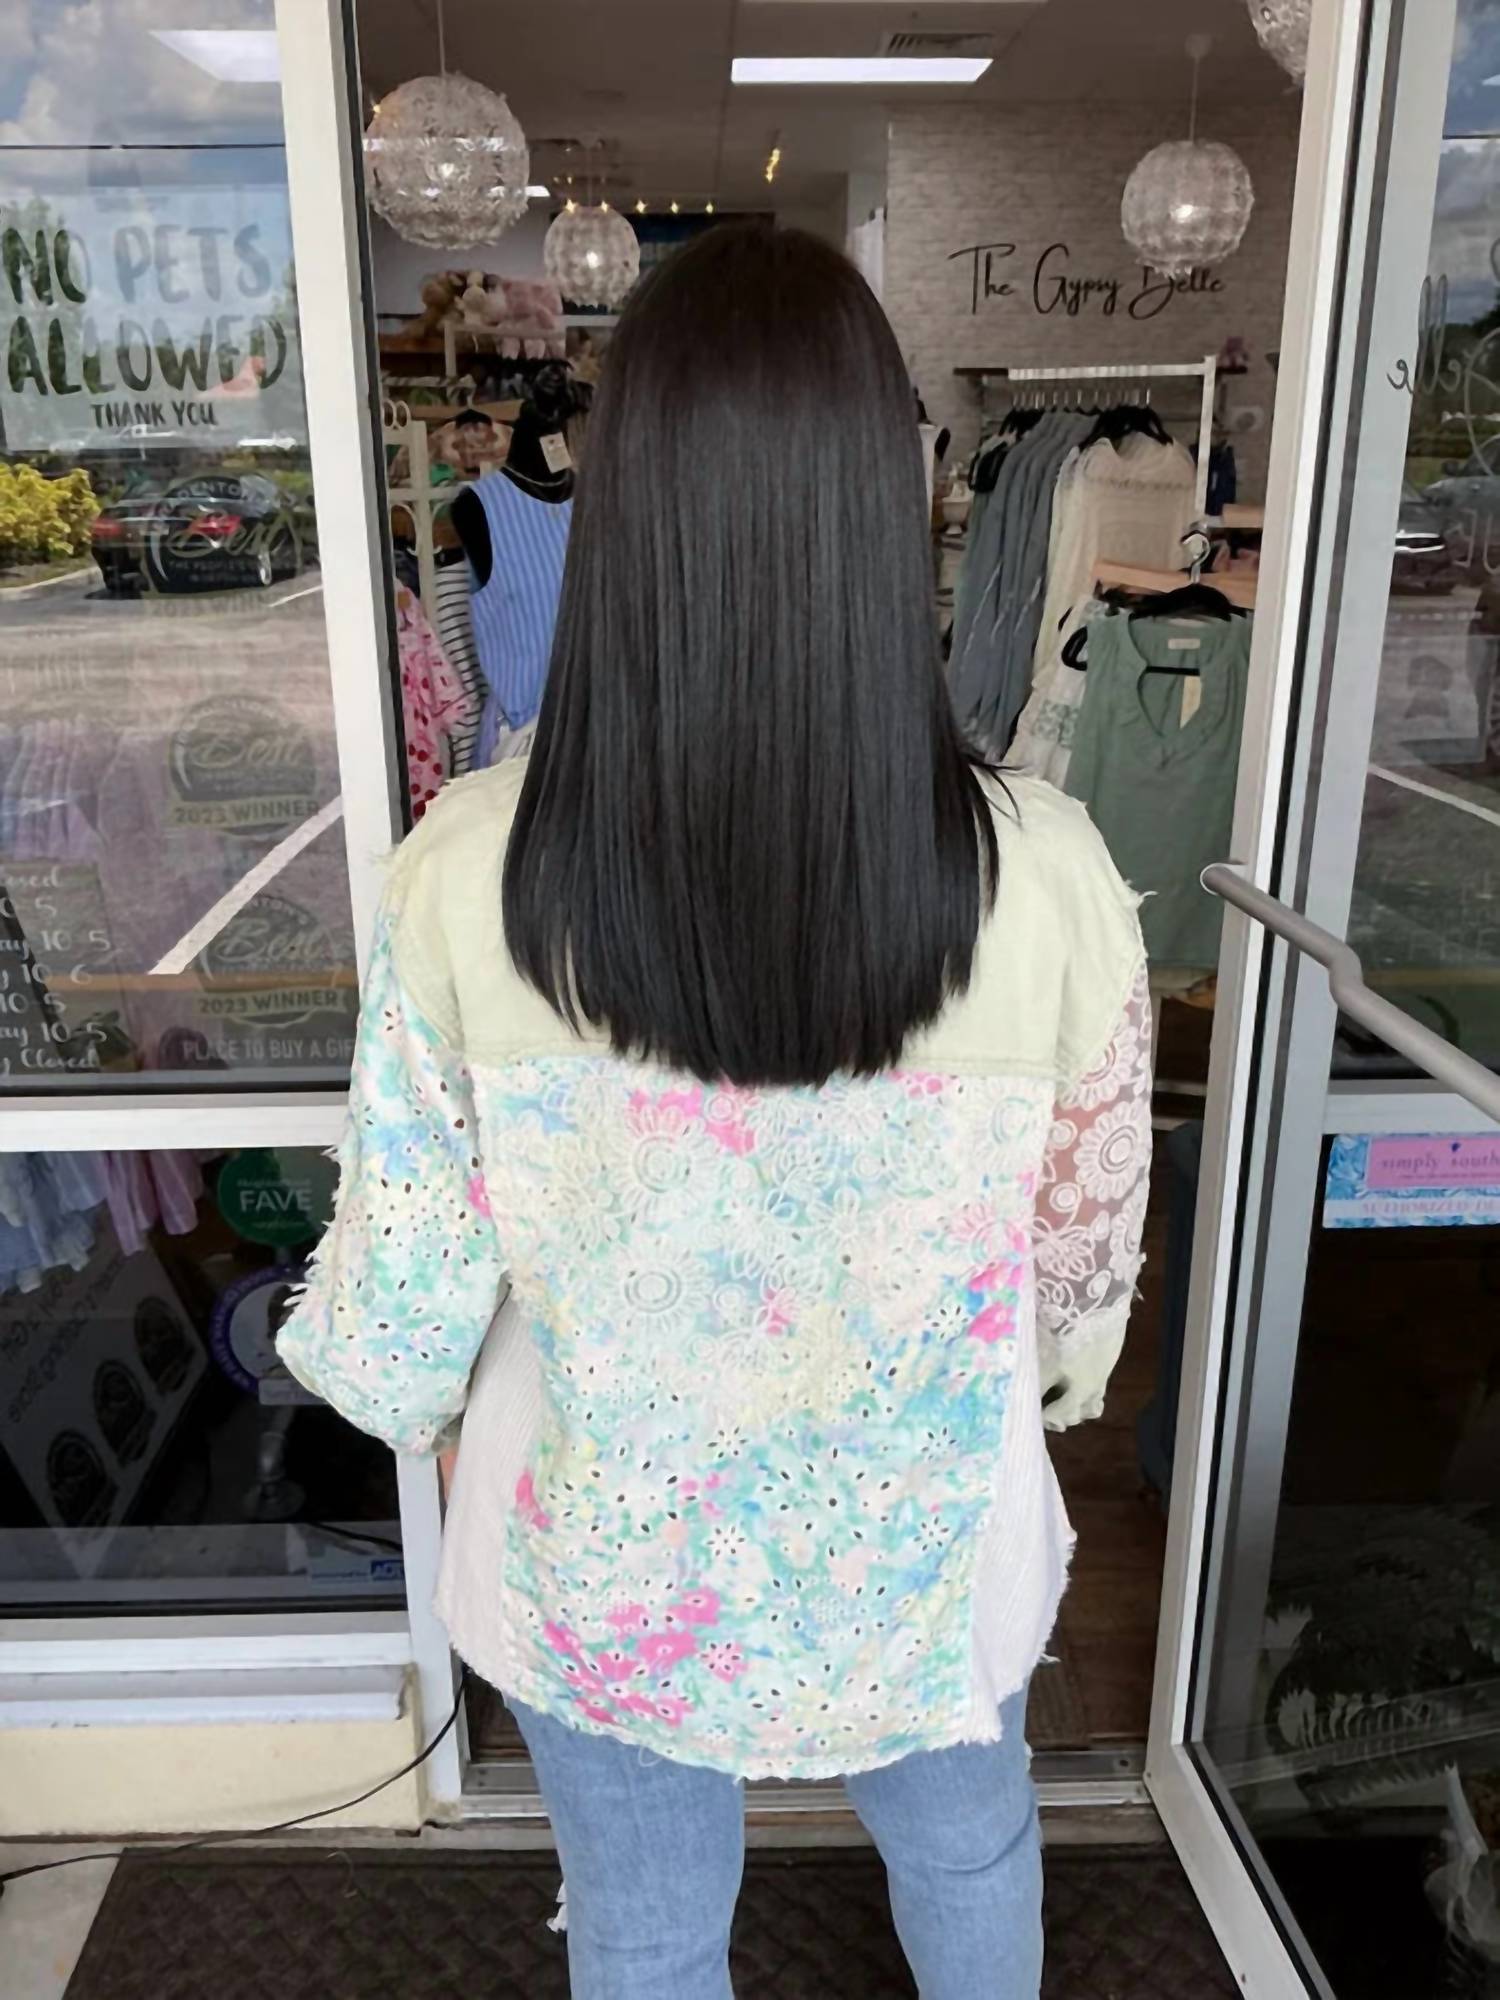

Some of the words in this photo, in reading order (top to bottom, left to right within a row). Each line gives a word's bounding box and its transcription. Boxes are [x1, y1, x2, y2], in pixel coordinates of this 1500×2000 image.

[2, 228, 89, 305] NO
[114, 224, 273, 302] PETS
[947, 243, 1016, 315] The
[1033, 243, 1123, 316] Gypsy
[7, 315, 287, 396] ALLOWED
[90, 402, 165, 428] THANK
[172, 401, 219, 427] YOU
[231, 800, 319, 822] WINNER
[35, 896, 57, 918] 5
[40, 930, 73, 952] 10
[88, 930, 111, 952] 5
[21, 963, 53, 985] 10
[70, 963, 93, 985] 6
[43, 992, 67, 1014] 5
[200, 997, 248, 1014] 2023
[252, 990, 338, 1009] WINNER
[40, 1021, 73, 1043] 10
[86, 1021, 108, 1043] 5
[242, 1037, 266, 1060] TO
[269, 1037, 305, 1060] BUY
[309, 1036, 323, 1058] A
[325, 1035, 357, 1057] GIF
[239, 1189, 312, 1213] FAVE
